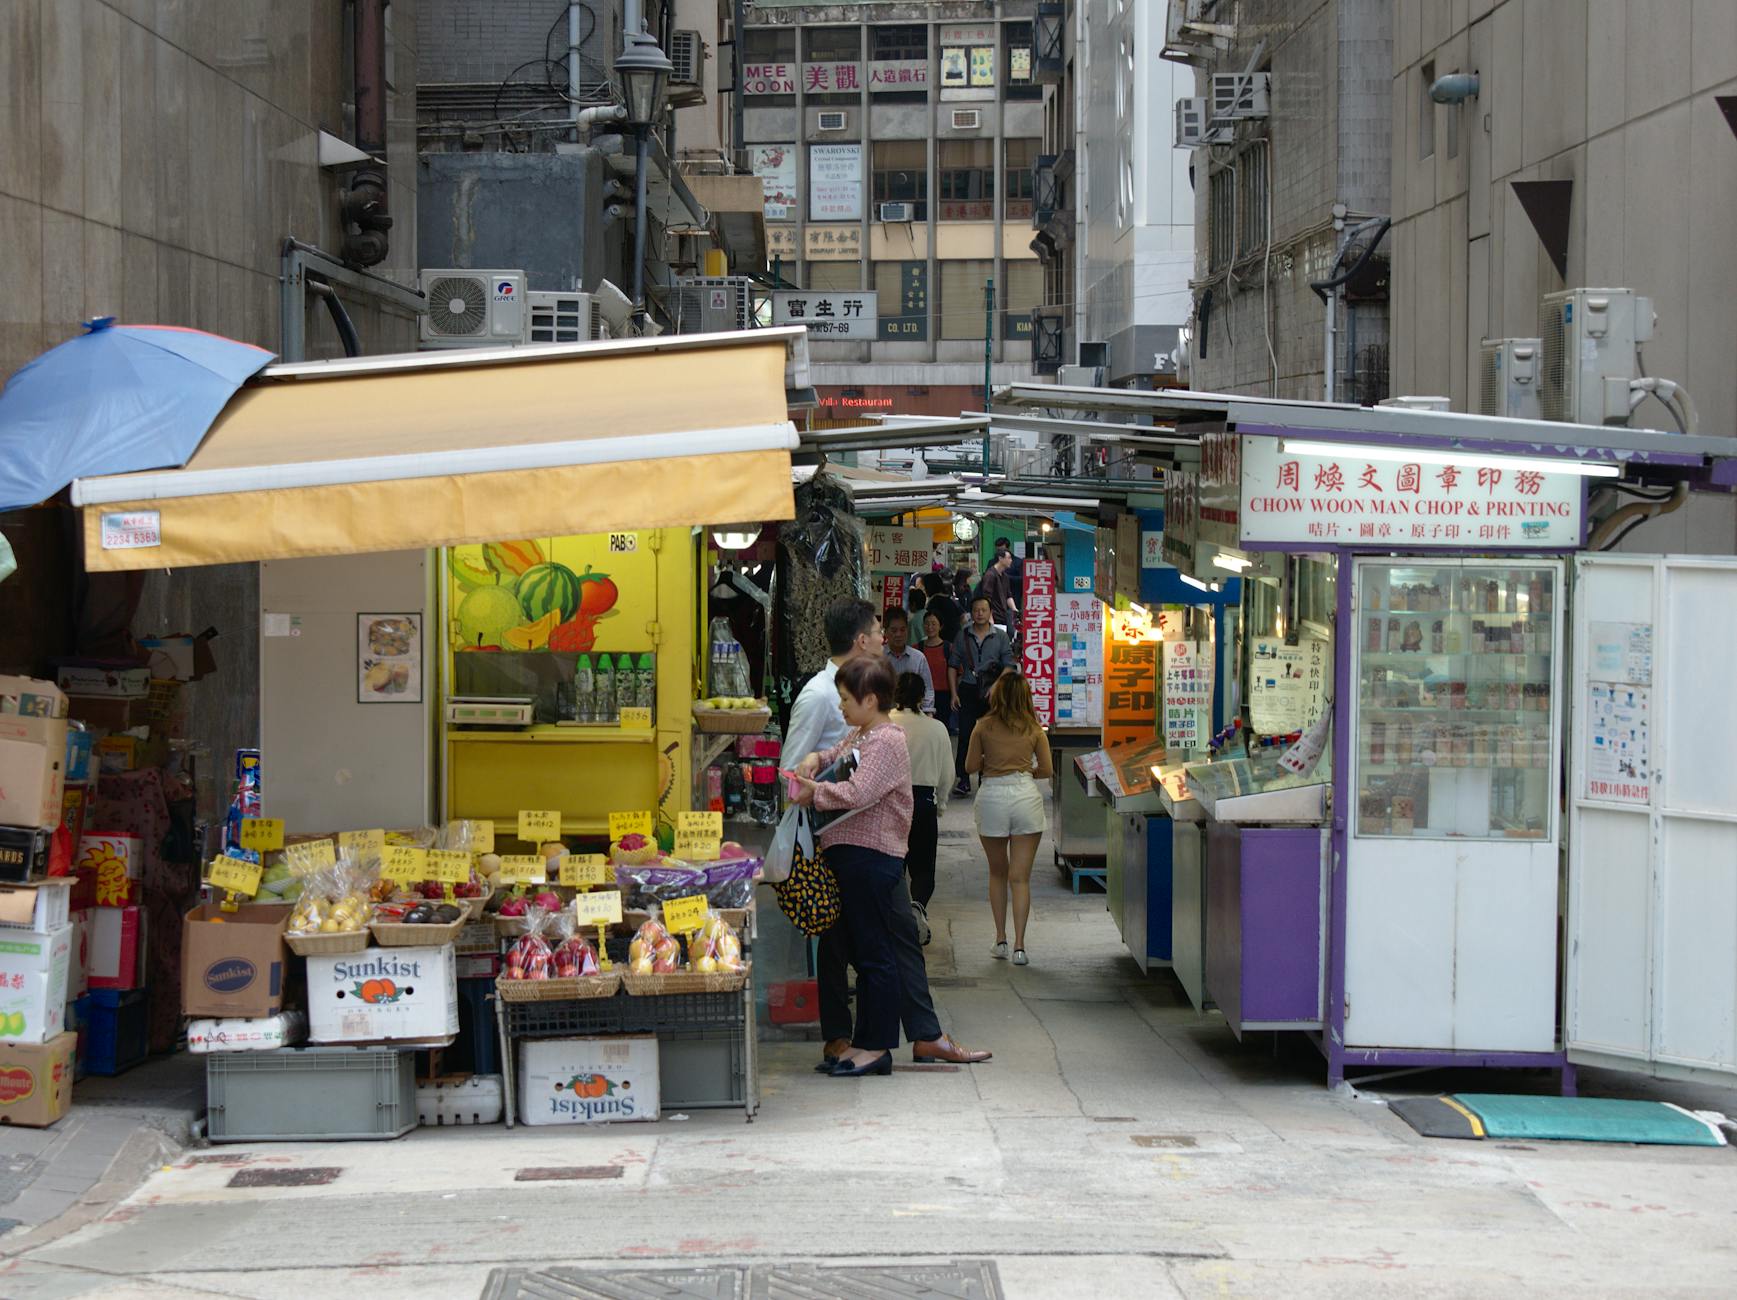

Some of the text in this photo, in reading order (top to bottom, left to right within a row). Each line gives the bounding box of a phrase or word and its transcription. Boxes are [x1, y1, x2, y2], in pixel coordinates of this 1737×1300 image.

[746, 65, 787, 78] MEE
[805, 64, 860, 92] 美觀
[743, 80, 795, 93] KOON
[787, 299, 864, 317] 富生行
[887, 322, 919, 333] CO. LTD.
[841, 397, 894, 407] Restaurant
[1276, 460, 1546, 497] 周煥文圖章印務
[1250, 497, 1571, 517] CHOW WOON MAN CHOP & PRINTING
[207, 966, 253, 984] Sunkist
[333, 955, 421, 982] Sunkist
[549, 1096, 635, 1119] Sunkist
